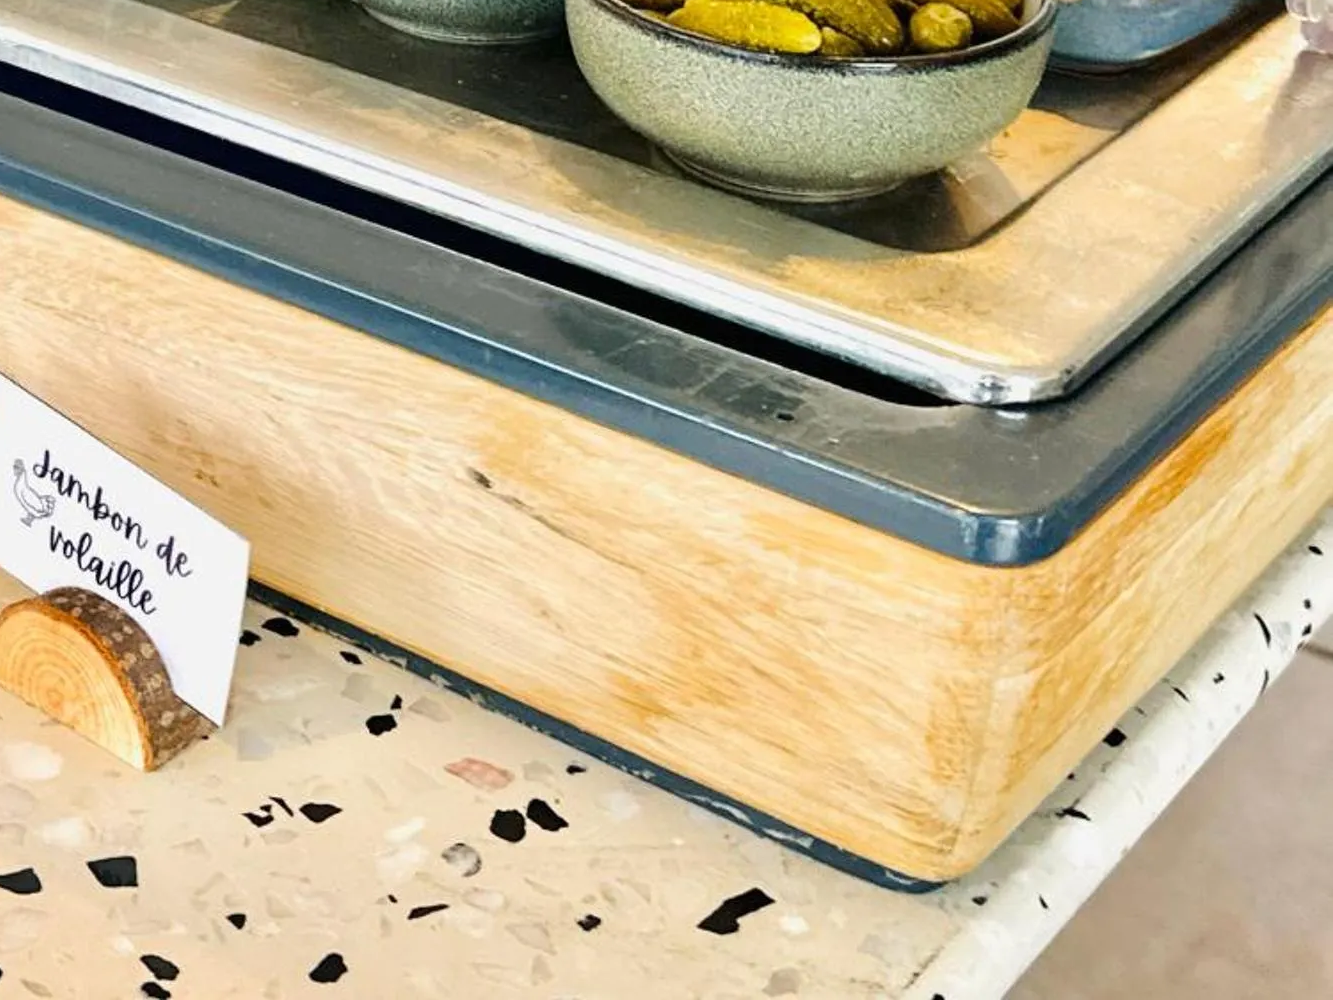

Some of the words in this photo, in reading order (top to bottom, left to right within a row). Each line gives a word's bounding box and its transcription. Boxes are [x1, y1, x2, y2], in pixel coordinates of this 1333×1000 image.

[33, 450, 148, 549] Jambon
[157, 537, 193, 577] de
[49, 526, 157, 615] volaille
